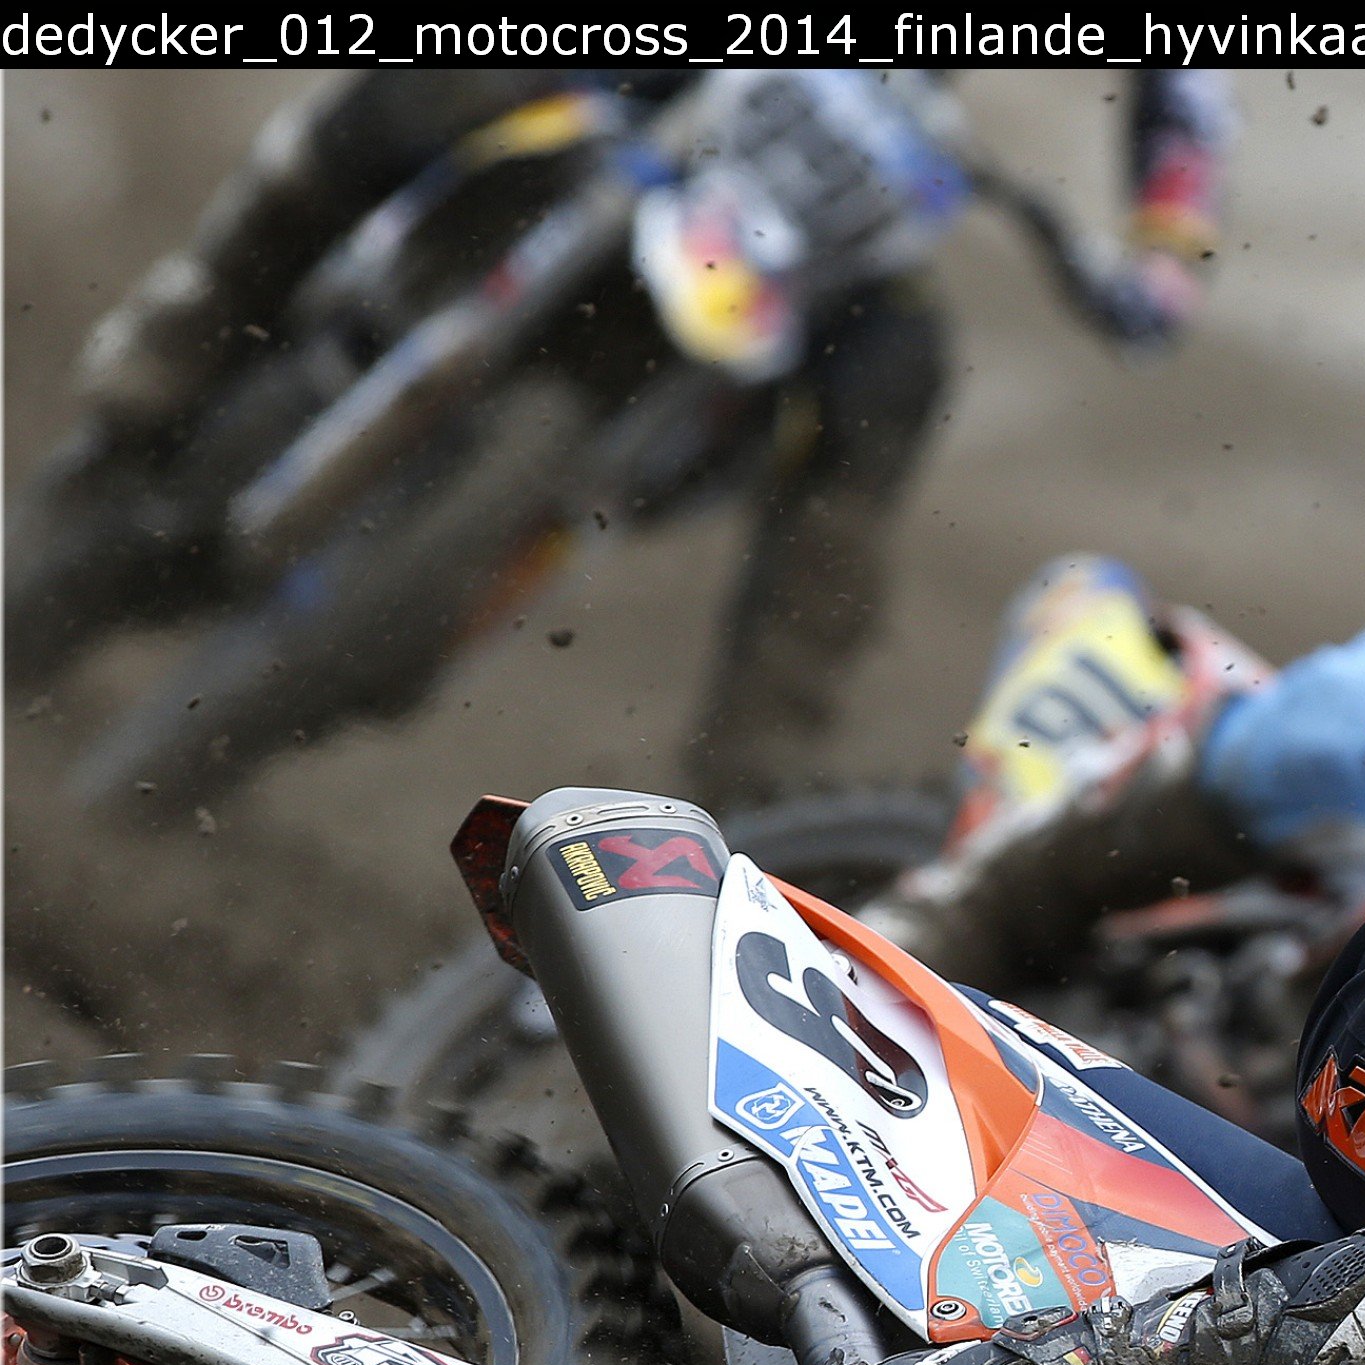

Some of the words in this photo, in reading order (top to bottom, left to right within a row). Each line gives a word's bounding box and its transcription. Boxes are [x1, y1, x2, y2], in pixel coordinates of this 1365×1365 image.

[779, 1125, 897, 1251] MAPEI
[803, 1086, 921, 1239] WWW.KTM.COM
[965, 1222, 1033, 1317] MOTORE
[1031, 1192, 1107, 1287] DIMOCO
[222, 1293, 313, 1336] brembo
[966, 1258, 1004, 1325] Switzerlan
